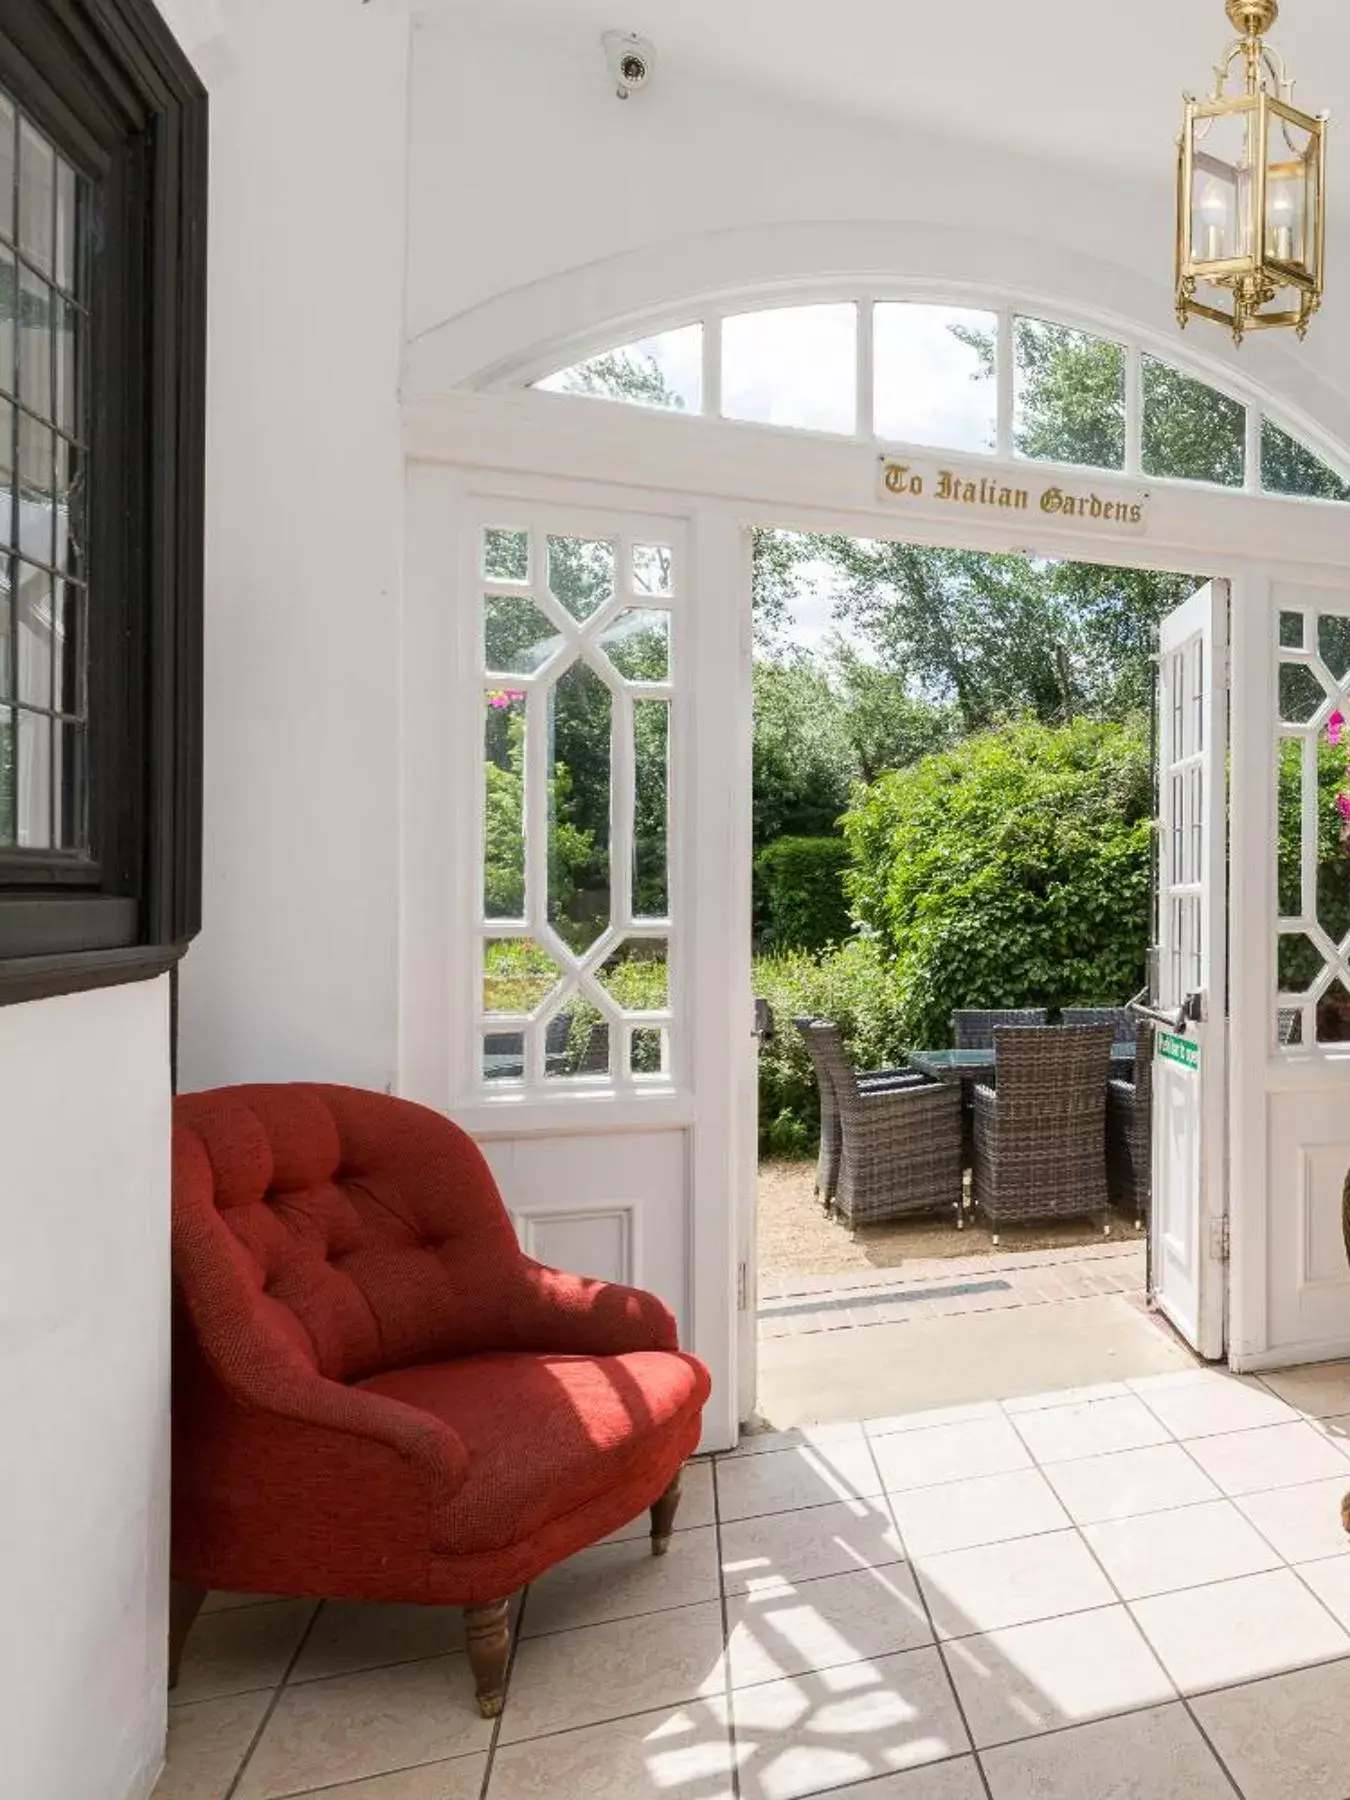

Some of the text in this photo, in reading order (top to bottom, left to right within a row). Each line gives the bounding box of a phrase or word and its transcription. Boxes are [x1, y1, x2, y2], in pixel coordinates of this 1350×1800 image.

[884, 463, 1142, 524] To Italian Gardens
